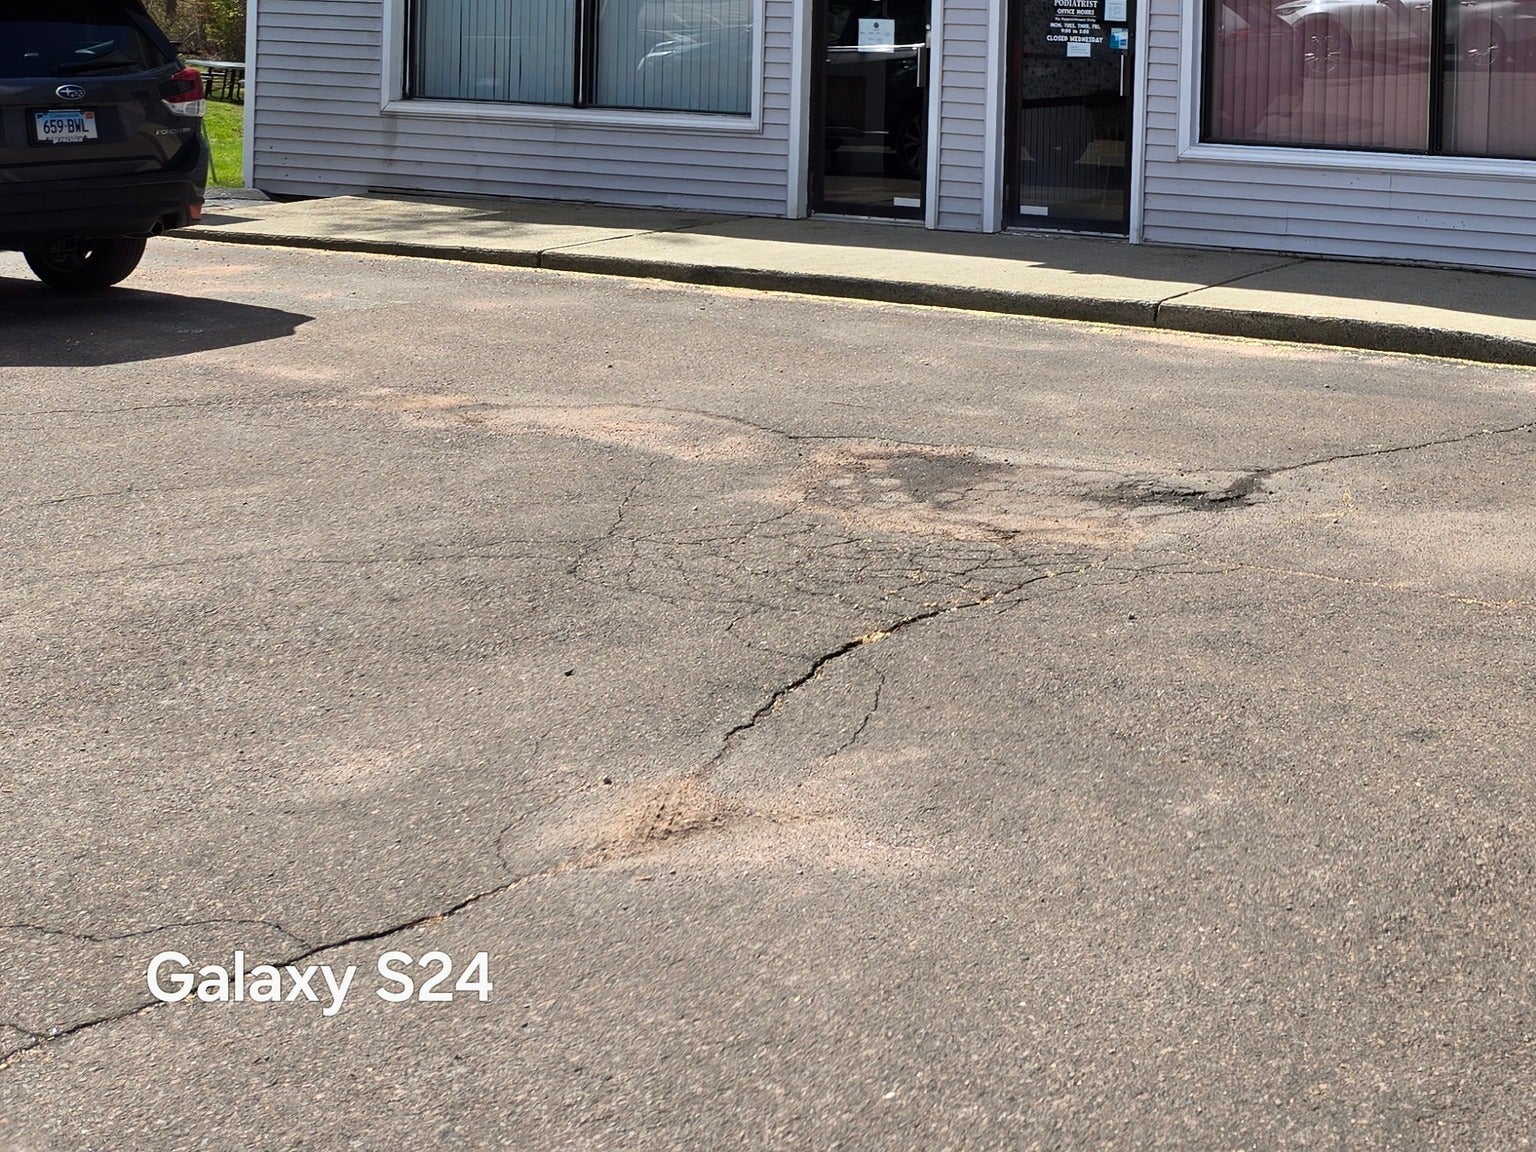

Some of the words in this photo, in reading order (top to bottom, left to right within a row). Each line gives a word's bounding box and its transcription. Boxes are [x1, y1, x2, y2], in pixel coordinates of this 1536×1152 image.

[1054, 0, 1098, 8] PODIATRIST
[1046, 34, 1068, 42] CLOSED
[1069, 35, 1104, 43] WEDNESDAY
